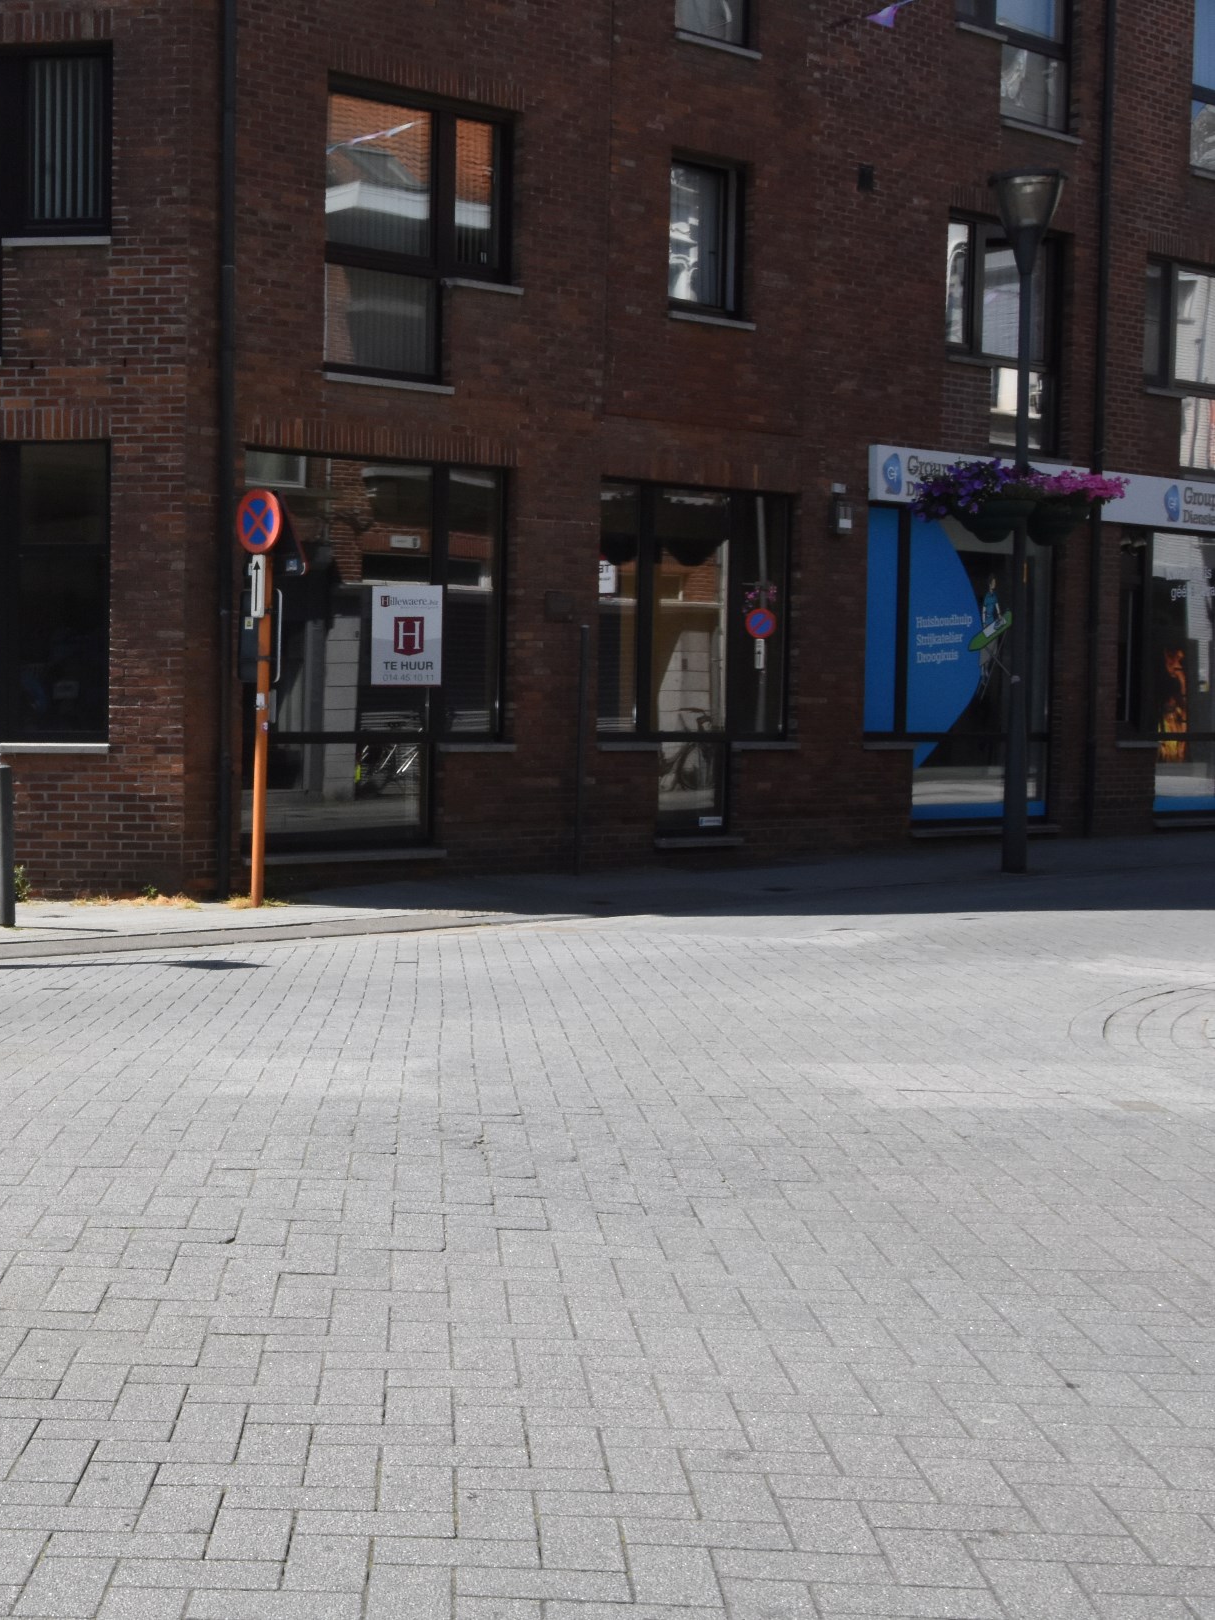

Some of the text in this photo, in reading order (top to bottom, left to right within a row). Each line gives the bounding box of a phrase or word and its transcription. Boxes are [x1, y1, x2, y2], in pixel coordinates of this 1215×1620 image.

[916, 614, 972, 628] Huishoudhulp
[397, 620, 422, 650] H
[916, 633, 963, 647] Strijkatelier
[916, 650, 959, 664] Droogkuis
[383, 661, 434, 671] TE HUUR
[382, 673, 398, 682] 014
[401, 673, 412, 682] 45
[414, 673, 423, 682] 10
